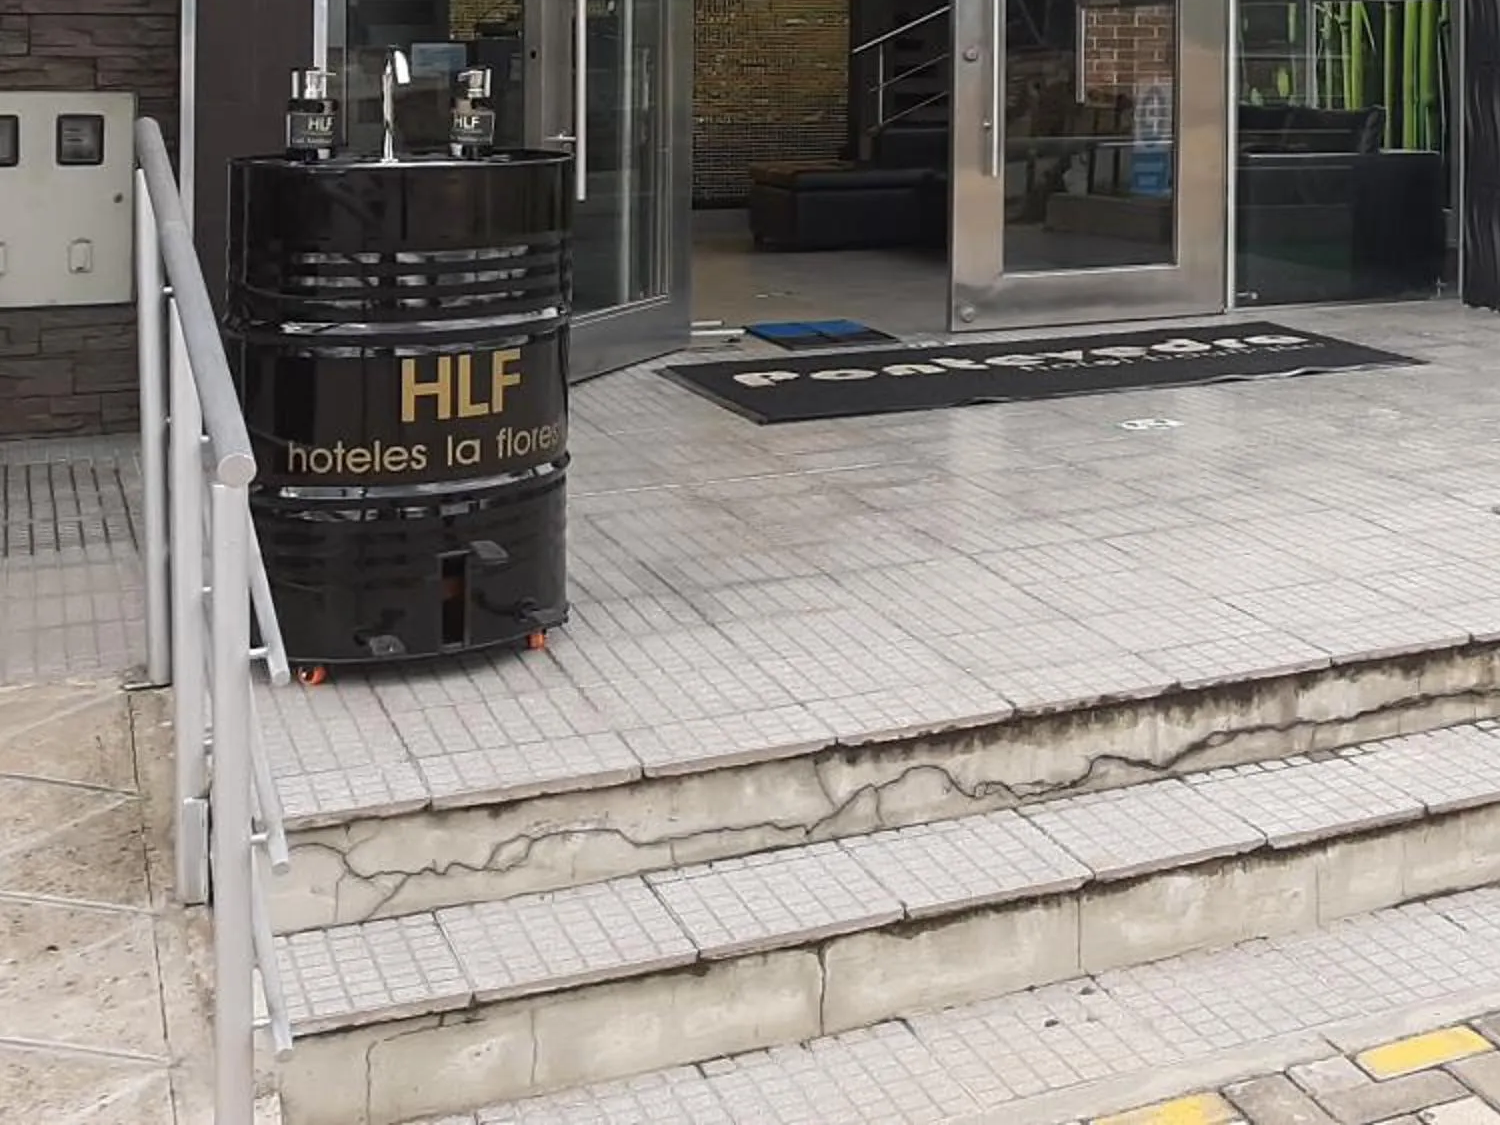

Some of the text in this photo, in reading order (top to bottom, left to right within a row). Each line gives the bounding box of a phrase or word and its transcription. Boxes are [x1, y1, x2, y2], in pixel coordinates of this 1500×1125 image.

[453, 115, 480, 130] HLF
[401, 348, 521, 422] HLF
[287, 439, 428, 473] hoteles
[447, 435, 481, 465] la
